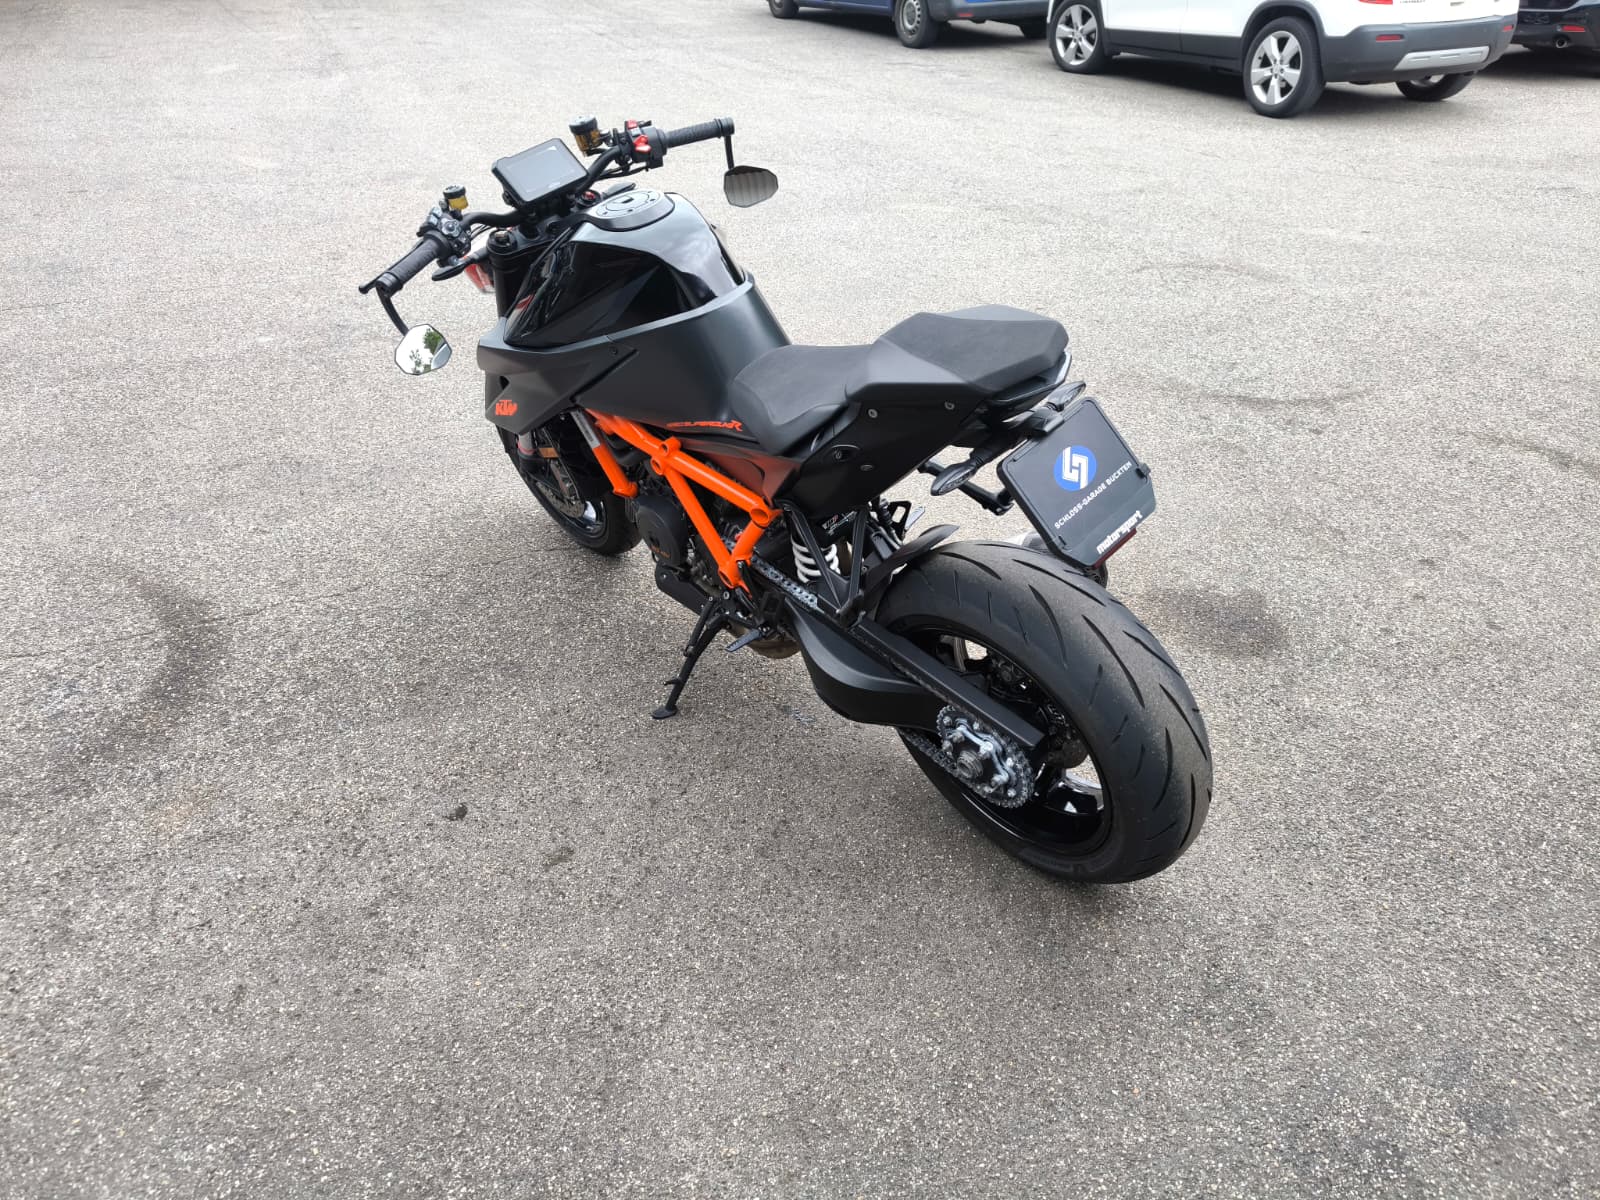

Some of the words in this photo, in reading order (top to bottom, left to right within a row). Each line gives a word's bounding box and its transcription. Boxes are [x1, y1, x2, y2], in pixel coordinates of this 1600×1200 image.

[495, 399, 518, 416] KTM
[1054, 482, 1107, 529] SCHLOSS-GARAGE
[1096, 509, 1143, 554] motorsport
